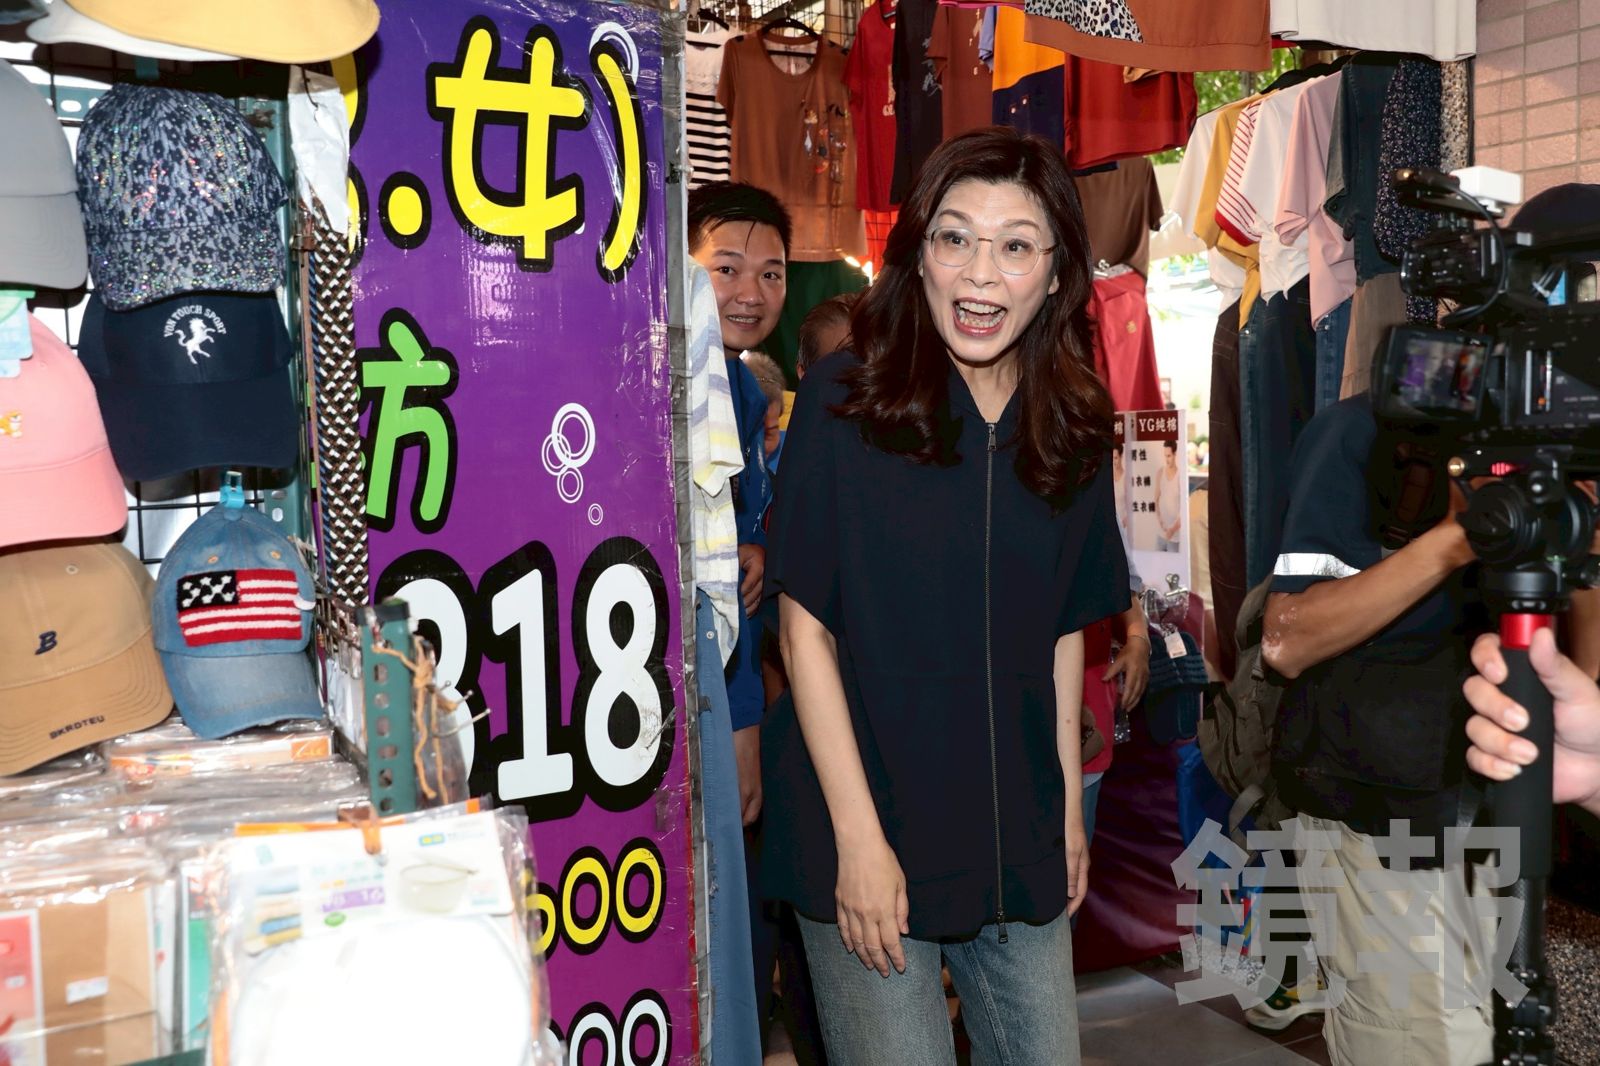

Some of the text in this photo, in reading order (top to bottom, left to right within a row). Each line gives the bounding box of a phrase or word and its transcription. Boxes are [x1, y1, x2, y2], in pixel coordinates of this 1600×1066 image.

[331, 28, 641, 271] .女)
[171, 304, 203, 321] TOUCH
[203, 308, 227, 335] SPORT
[34, 630, 58, 656] B
